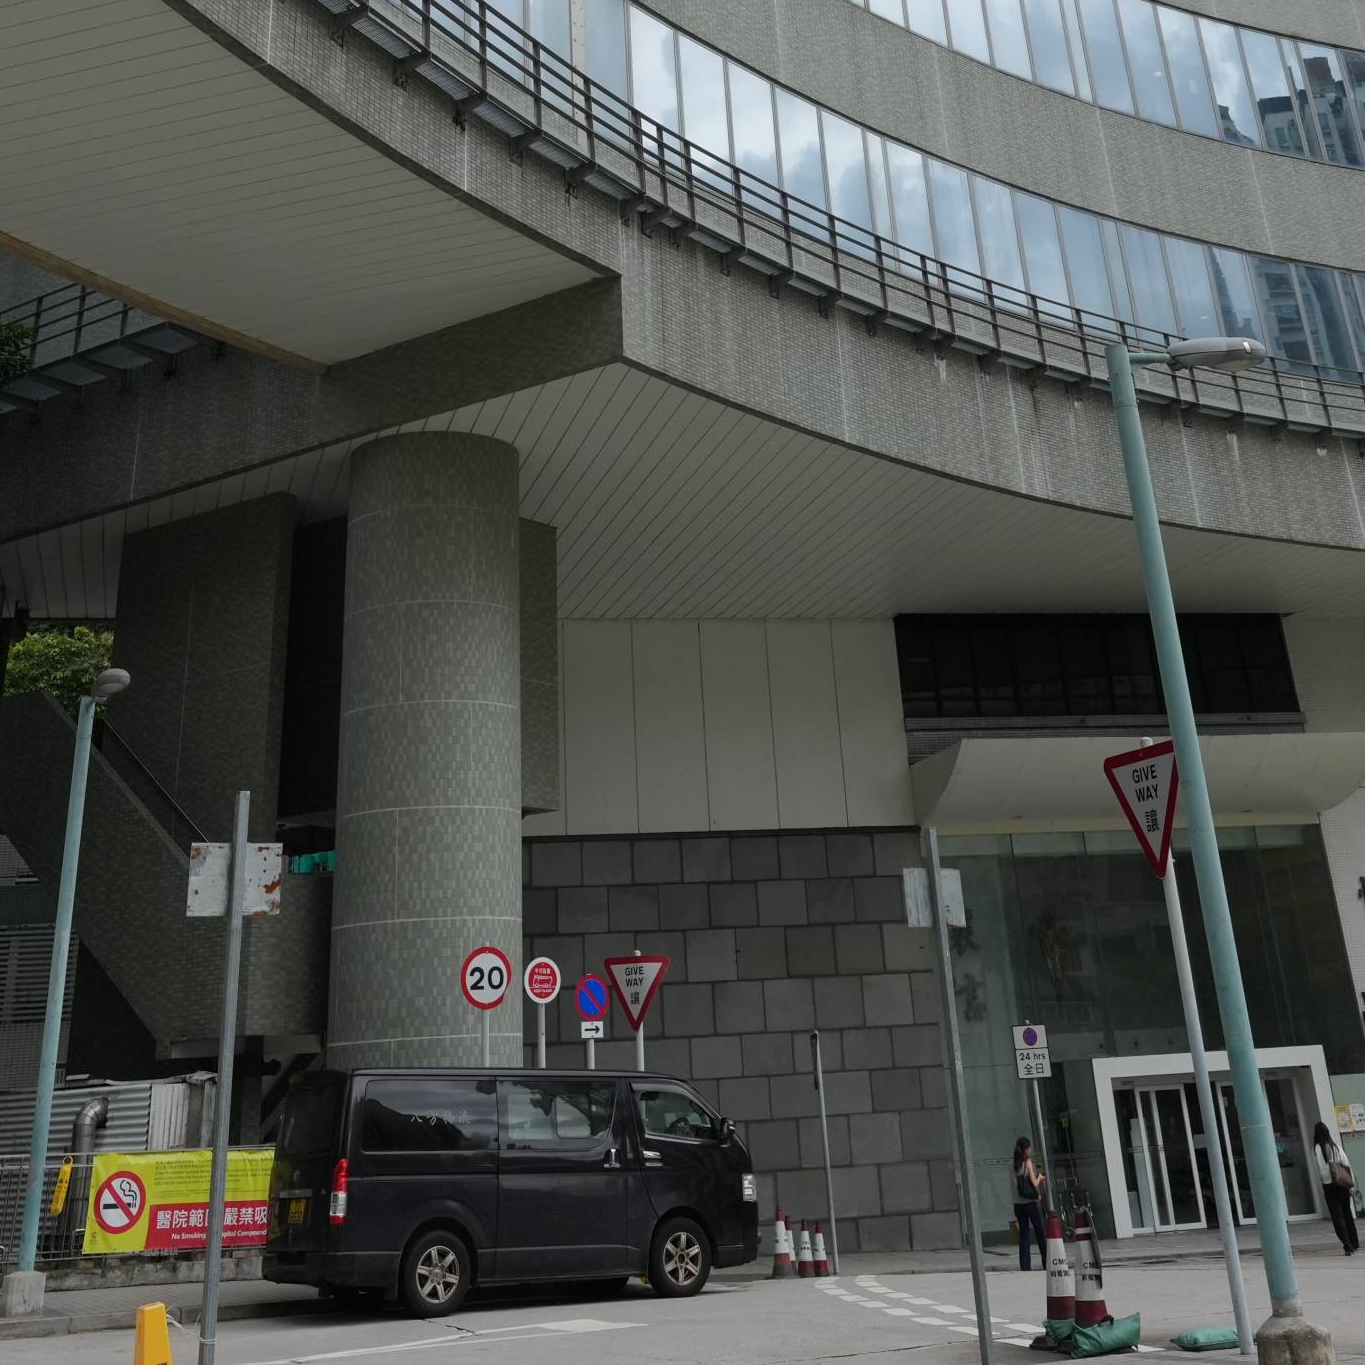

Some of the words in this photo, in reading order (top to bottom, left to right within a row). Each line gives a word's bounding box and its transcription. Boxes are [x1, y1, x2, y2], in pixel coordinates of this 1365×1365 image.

[1132, 765, 1157, 783] GIVE
[1135, 784, 1158, 803] WAY
[1145, 809, 1160, 832] 讓
[470, 966, 504, 990] 20
[625, 966, 644, 976] GIVE
[626, 978, 645, 987] WAY
[1019, 1052, 1031, 1061] 24
[1033, 1051, 1046, 1060] hrs
[1024, 1063, 1045, 1075] 全日
[156, 1207, 268, 1230] 醫院範嚴禁吸
[181, 1232, 207, 1241] Smoking
[237, 1228, 267, 1237] Compound
